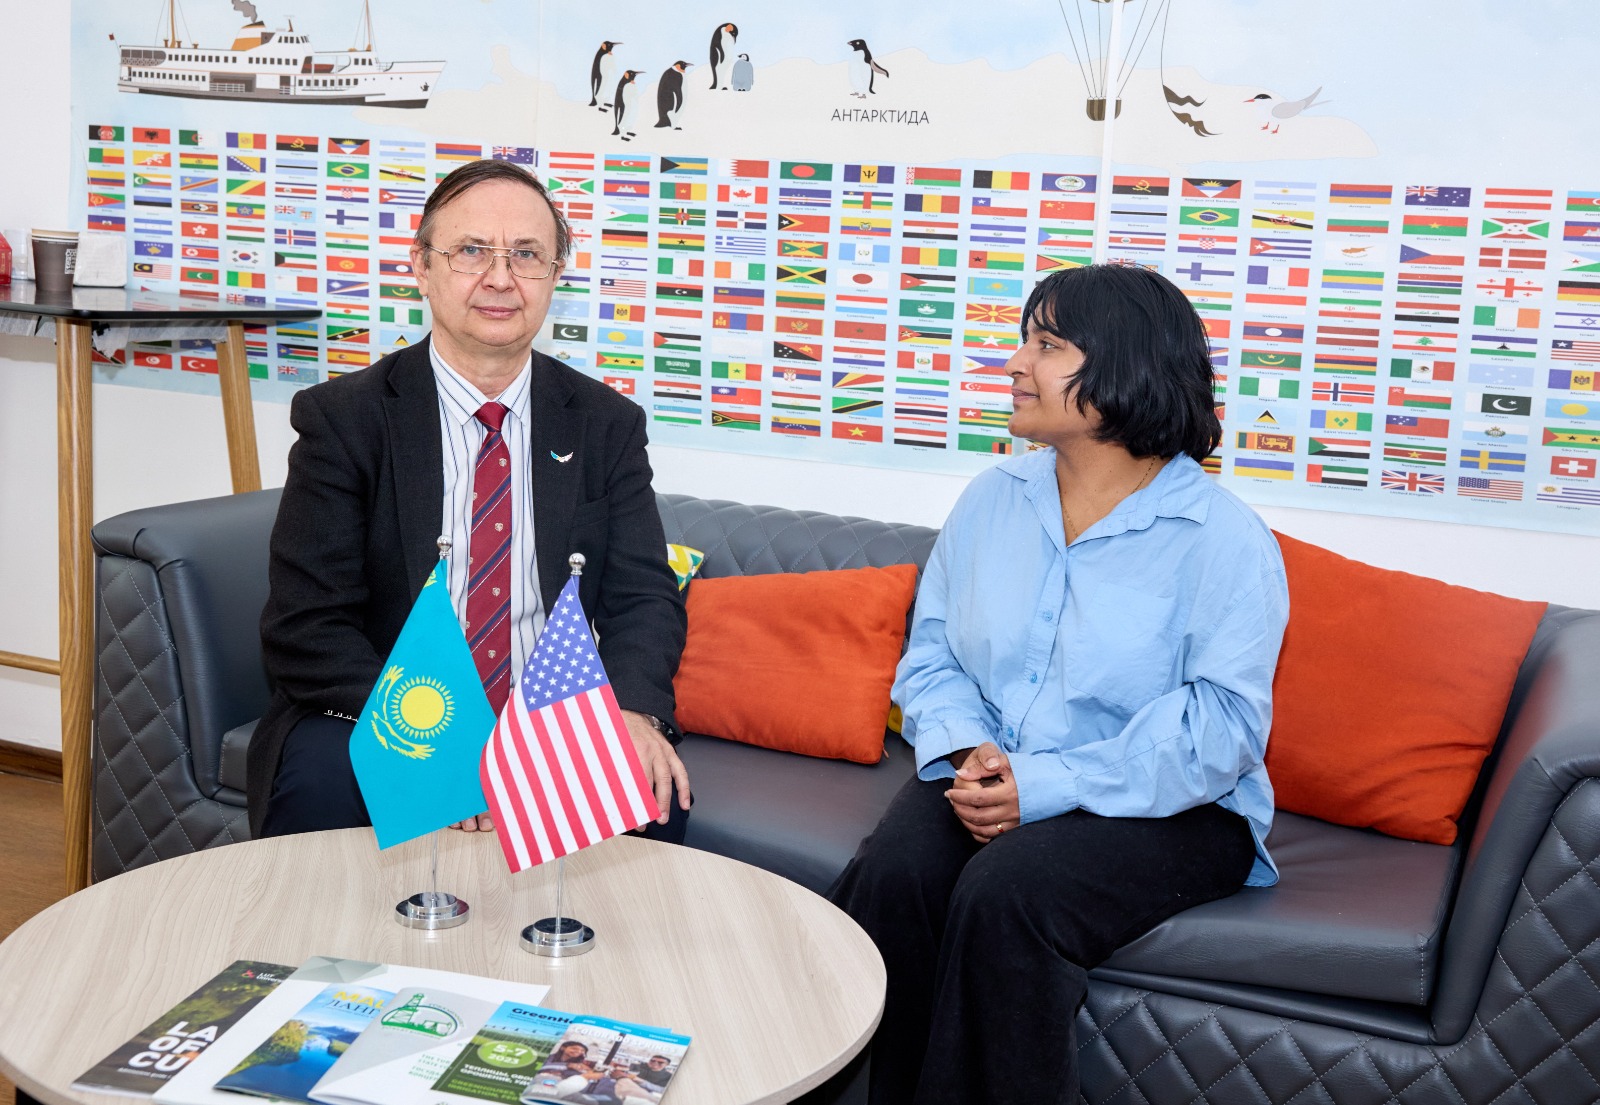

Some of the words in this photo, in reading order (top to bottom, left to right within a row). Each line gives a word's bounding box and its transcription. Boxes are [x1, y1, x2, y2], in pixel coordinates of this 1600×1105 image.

[831, 108, 930, 126] АНТАРКТИДА
[149, 1036, 208, 1055] OF
[492, 1043, 529, 1057] 5-7
[487, 1052, 521, 1066] 2023
